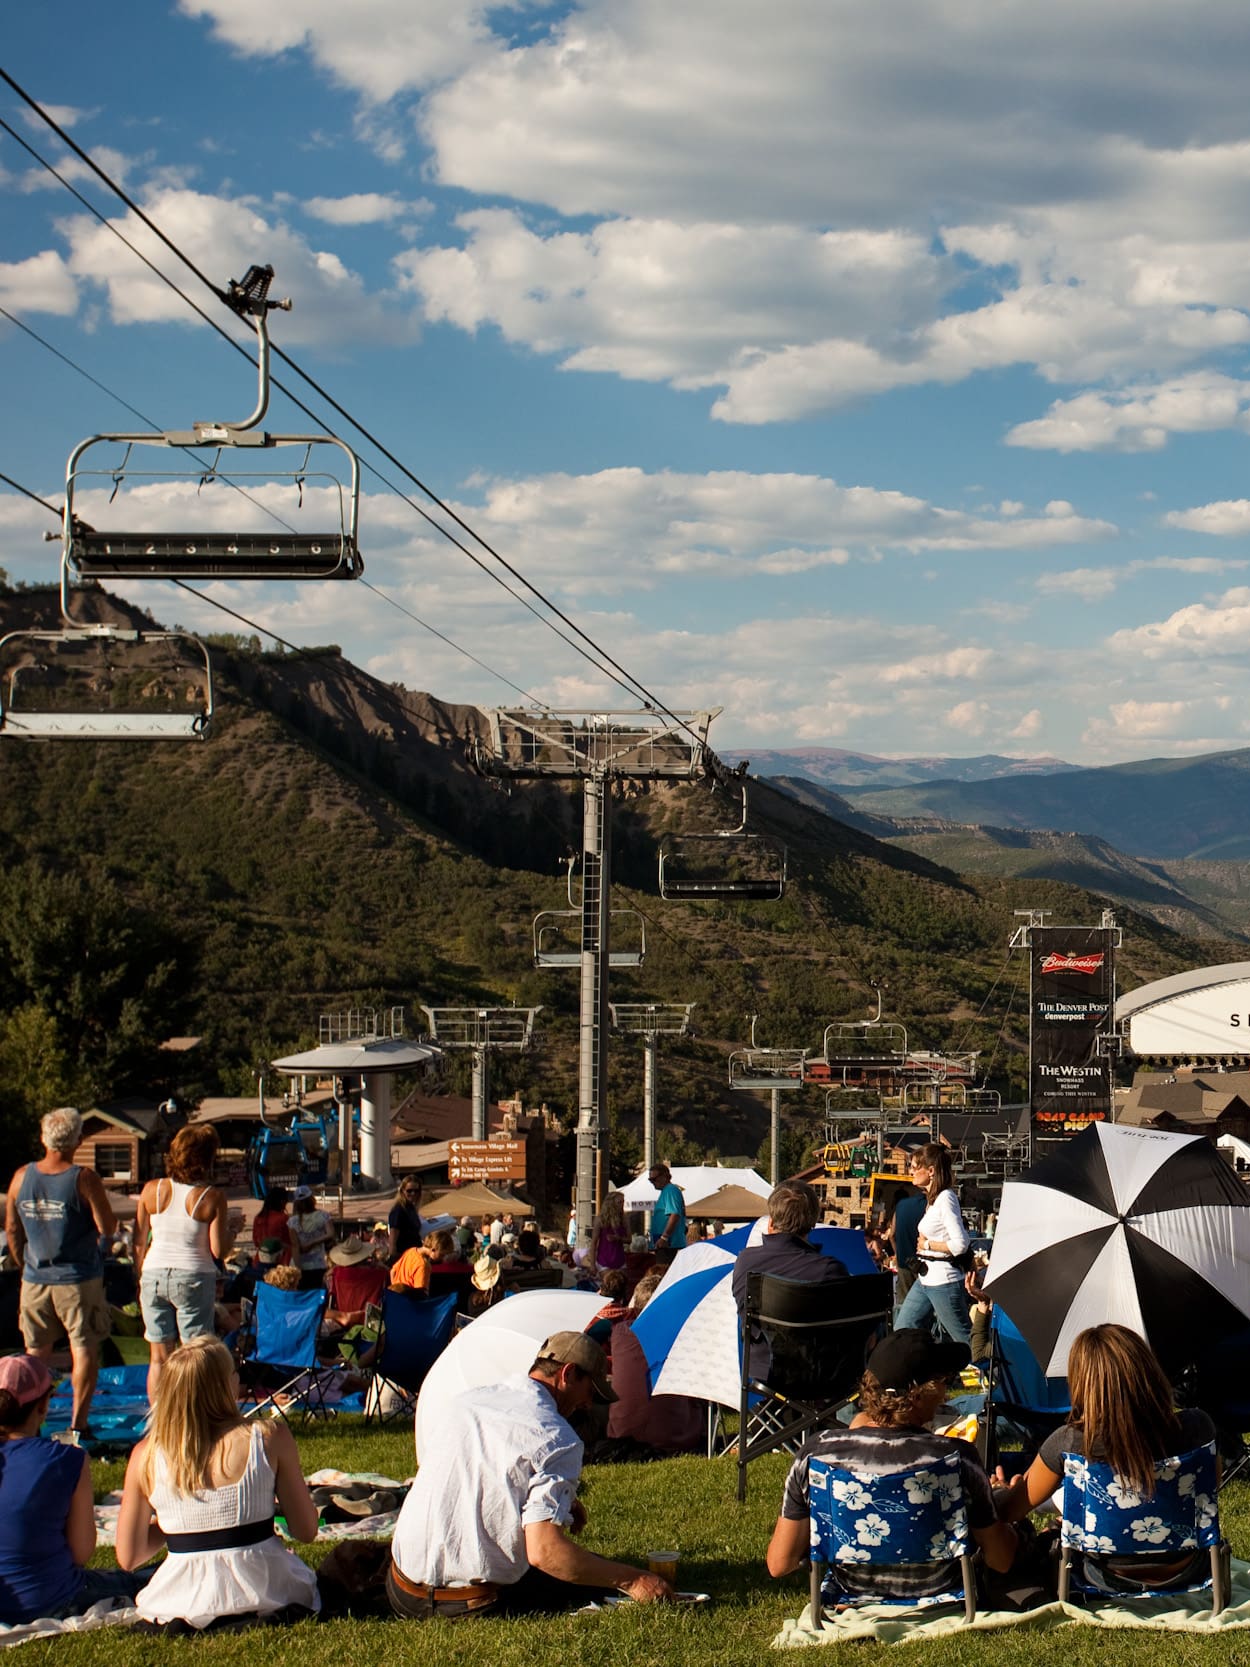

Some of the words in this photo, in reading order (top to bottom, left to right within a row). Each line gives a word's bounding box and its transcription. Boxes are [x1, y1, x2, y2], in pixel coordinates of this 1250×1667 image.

[145, 542, 156, 555] 2
[227, 541, 239, 555] 4
[1039, 956, 1104, 967] Budweiser
[1038, 1002, 1055, 1012] THE
[1056, 1002, 1087, 1012] DENVER
[1089, 1002, 1109, 1012] POST
[1039, 1065, 1060, 1076] THE
[1060, 1065, 1101, 1076] WESTIN
[488, 1143, 505, 1151] Village
